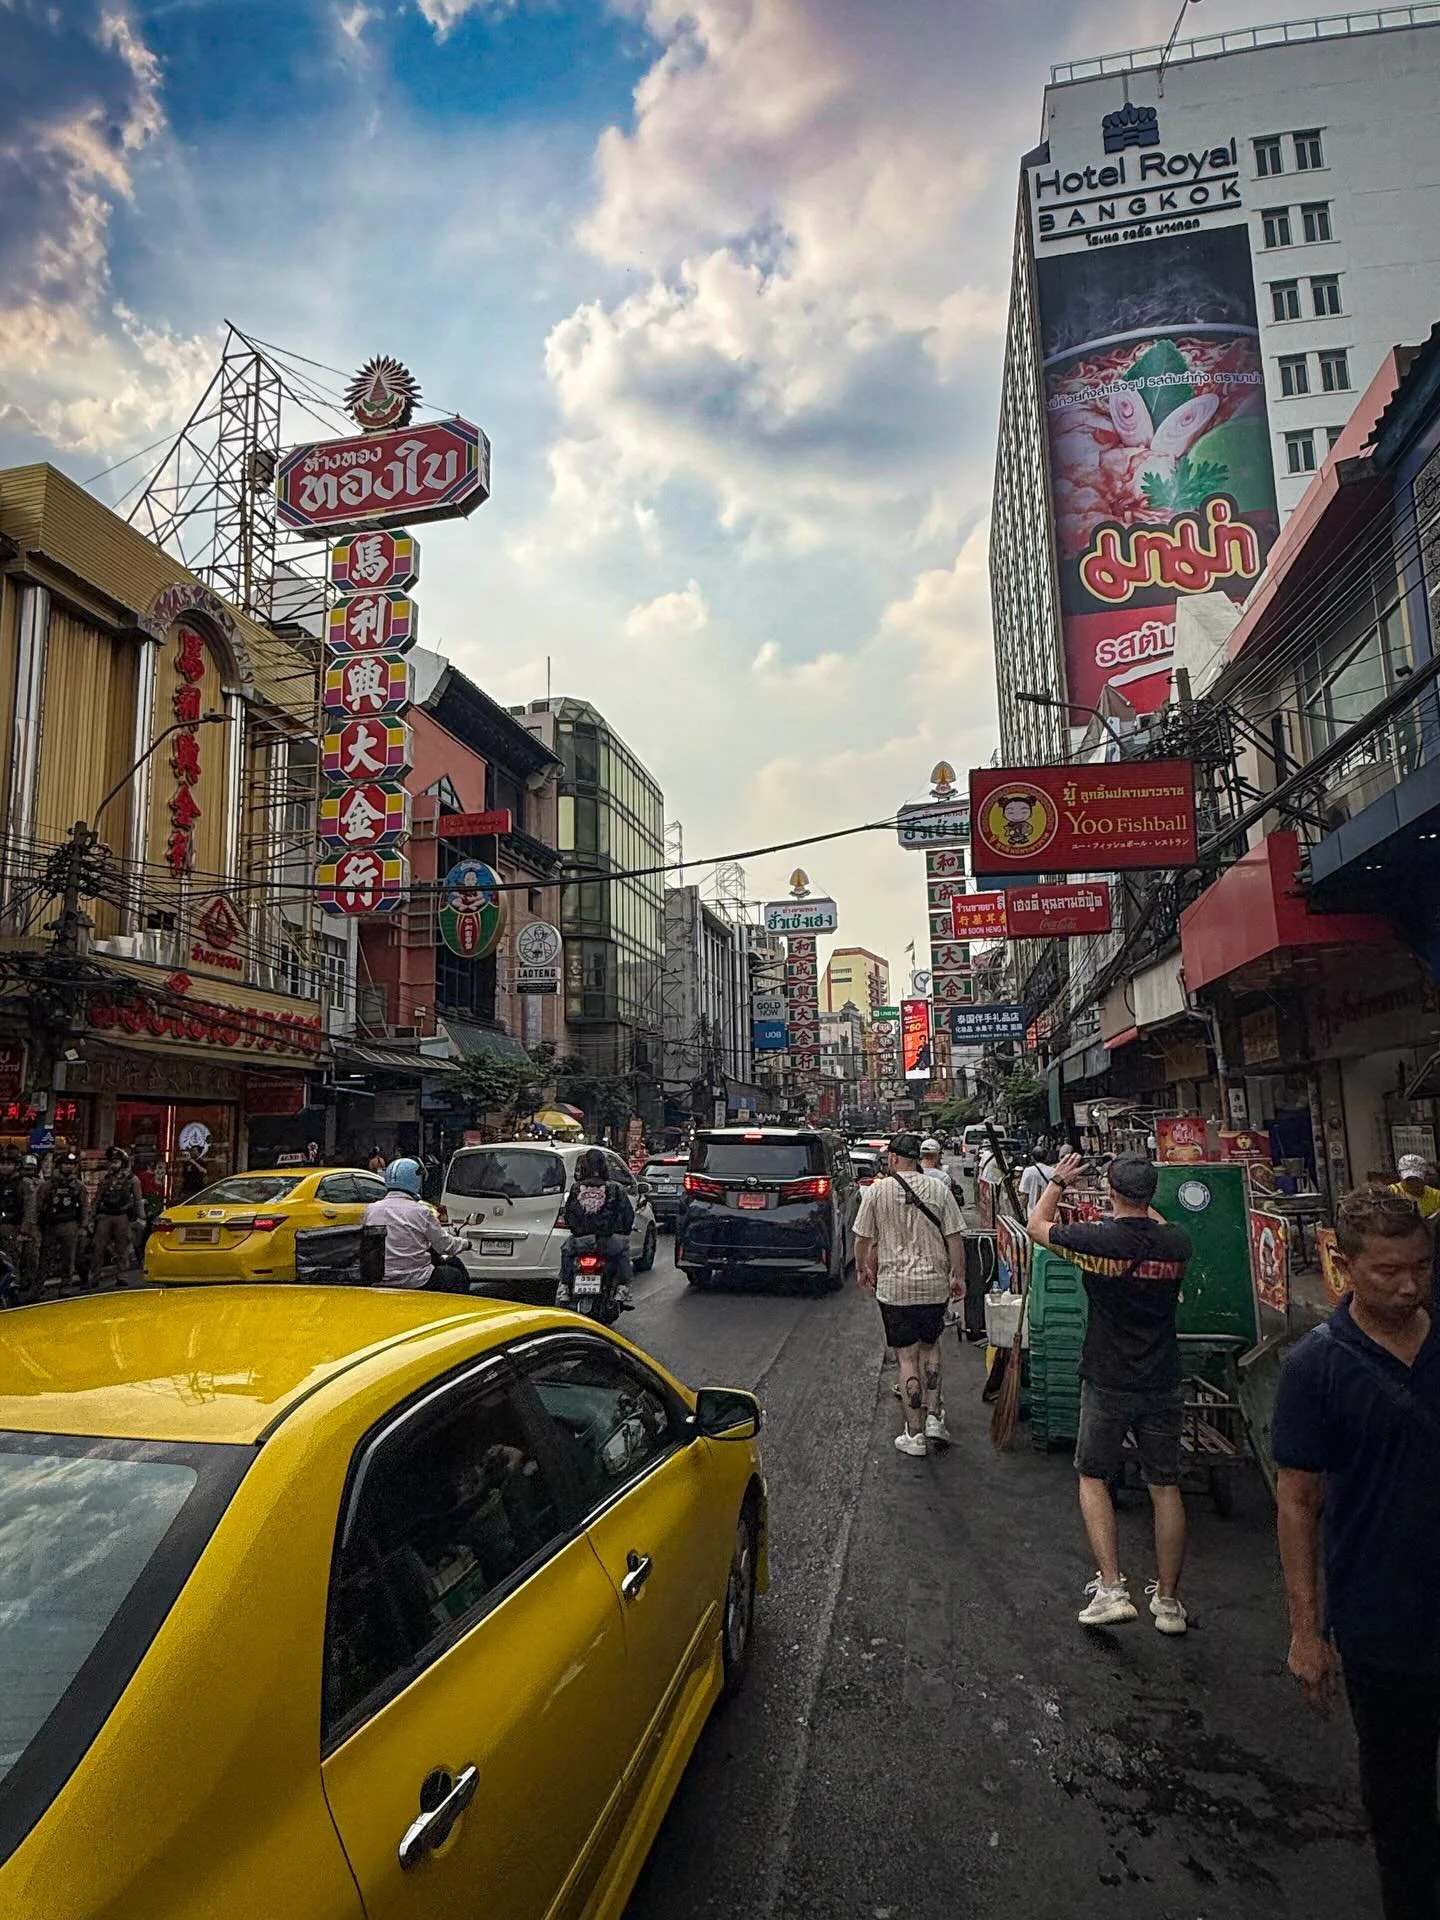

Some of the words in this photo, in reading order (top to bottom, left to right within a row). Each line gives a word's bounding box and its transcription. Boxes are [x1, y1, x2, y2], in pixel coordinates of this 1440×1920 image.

[1036, 156, 1126, 199] Hotel
[1139, 137, 1238, 181] Royal
[1038, 180, 1241, 233] BANGKOK
[303, 446, 382, 473] ห้างทอง
[299, 440, 459, 512] ทองใบ
[1081, 500, 1260, 602] มาม่า
[340, 535, 388, 906] 馬利興大金行
[1117, 814, 1187, 833] Fishball
[757, 1001, 781, 1011] GOLD
[760, 1008, 779, 1017] NOW
[957, 1012, 1020, 1025] 泰国伴手礼品店
[765, 1030, 782, 1039] UOB
